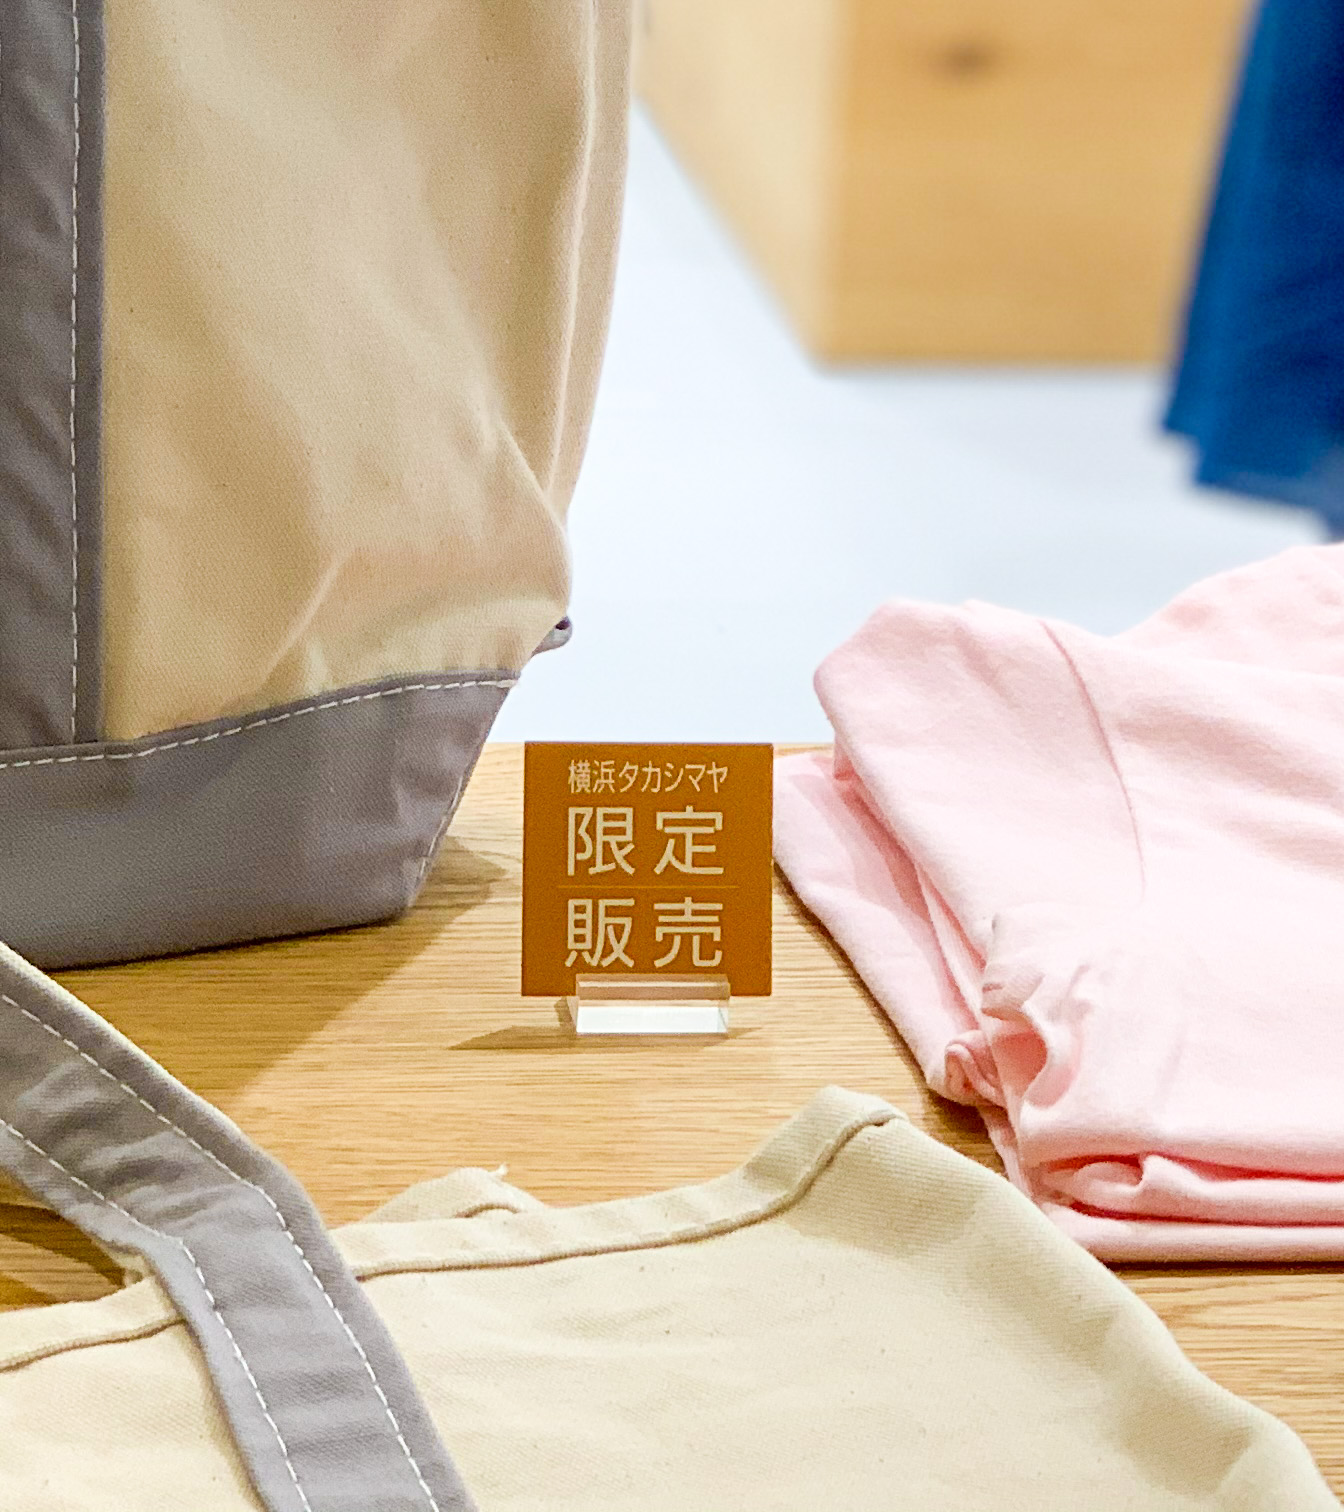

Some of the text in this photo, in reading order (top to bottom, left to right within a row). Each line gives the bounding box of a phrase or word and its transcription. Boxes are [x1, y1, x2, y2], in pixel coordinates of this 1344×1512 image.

[568, 759, 728, 794] 横浜タカシマヤ
[567, 805, 724, 876] 限定
[564, 896, 723, 968] 販売
